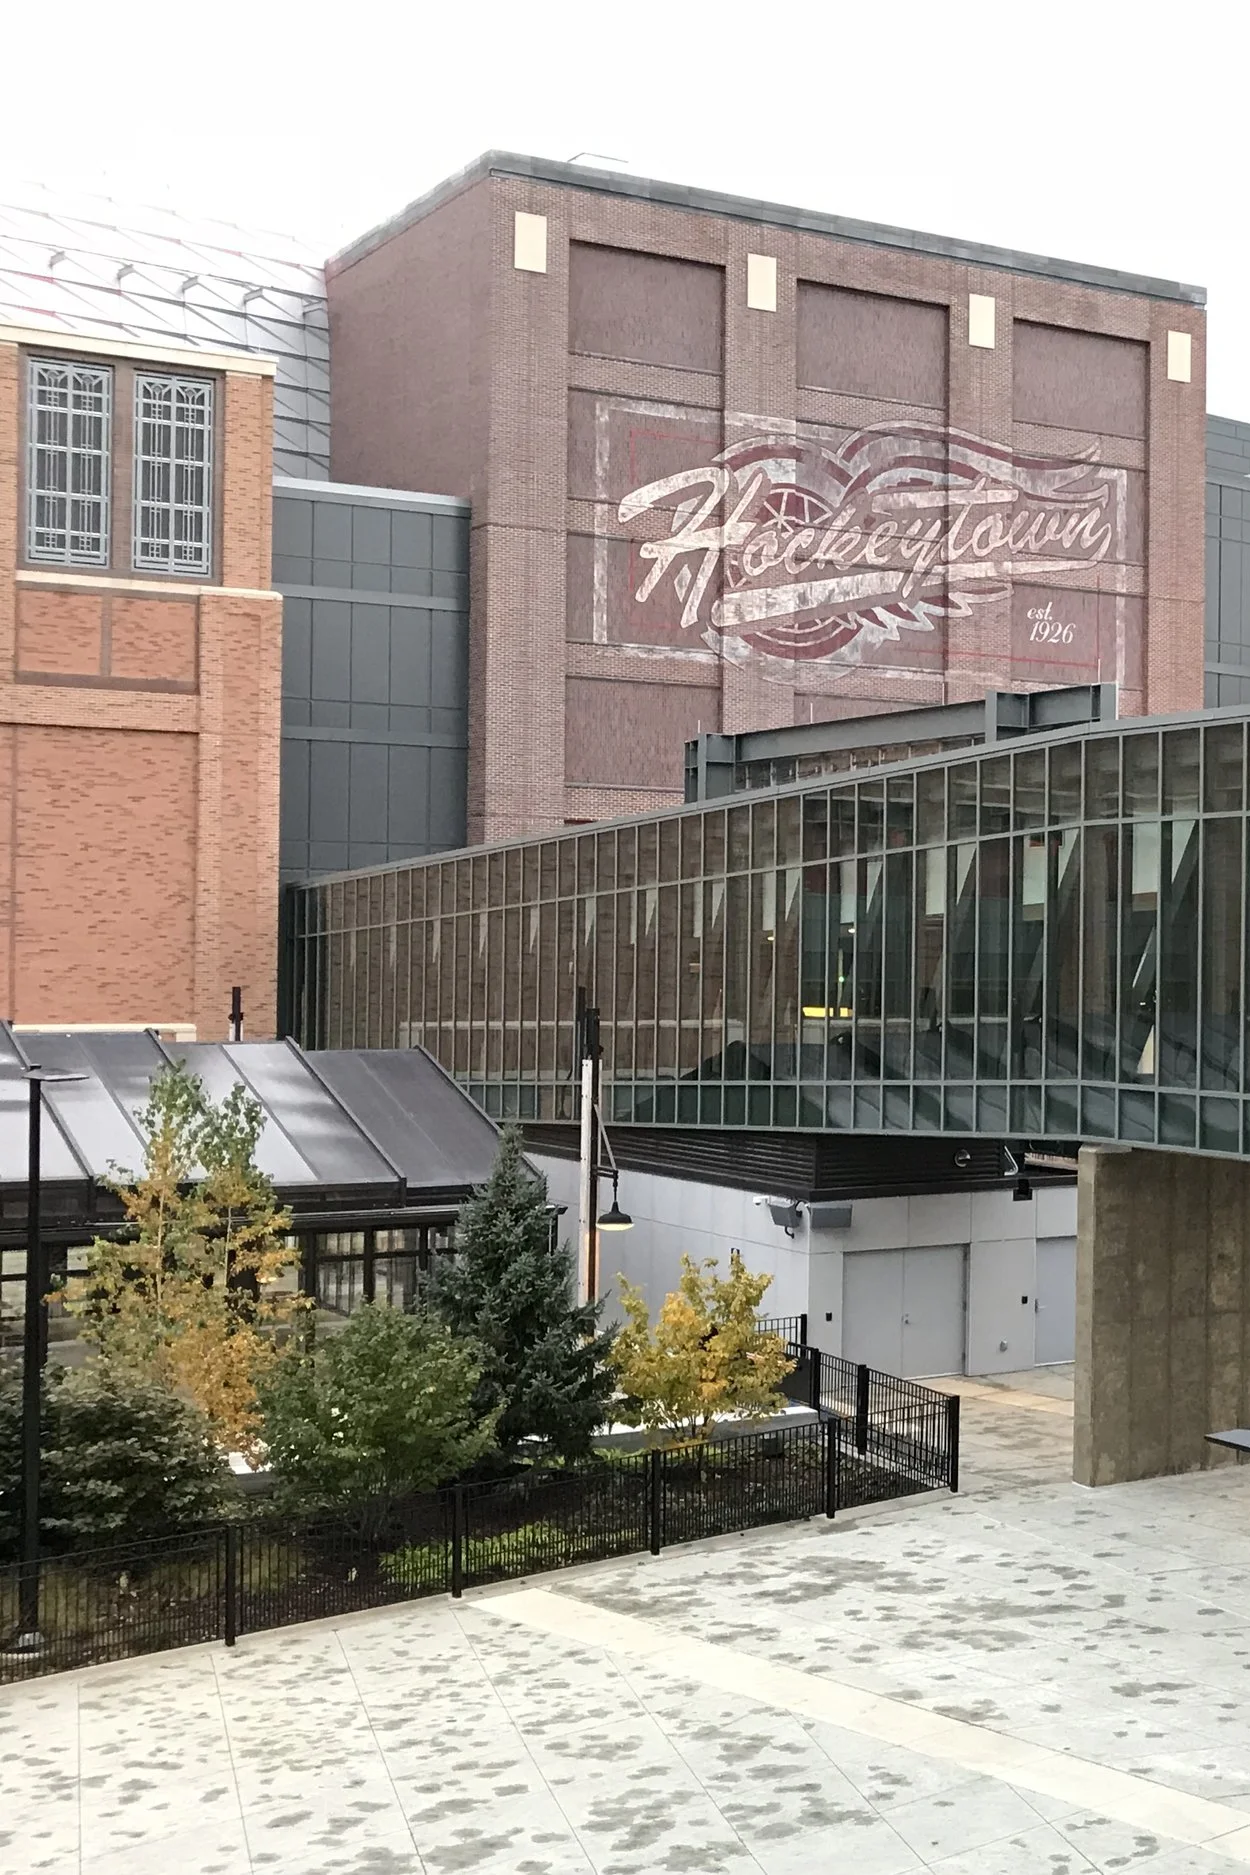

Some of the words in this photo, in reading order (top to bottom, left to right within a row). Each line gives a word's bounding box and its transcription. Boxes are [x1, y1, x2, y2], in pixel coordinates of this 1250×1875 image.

[617, 465, 1111, 628] Hockeytown
[1027, 601, 1053, 620] est.
[1029, 620, 1076, 644] 1926
